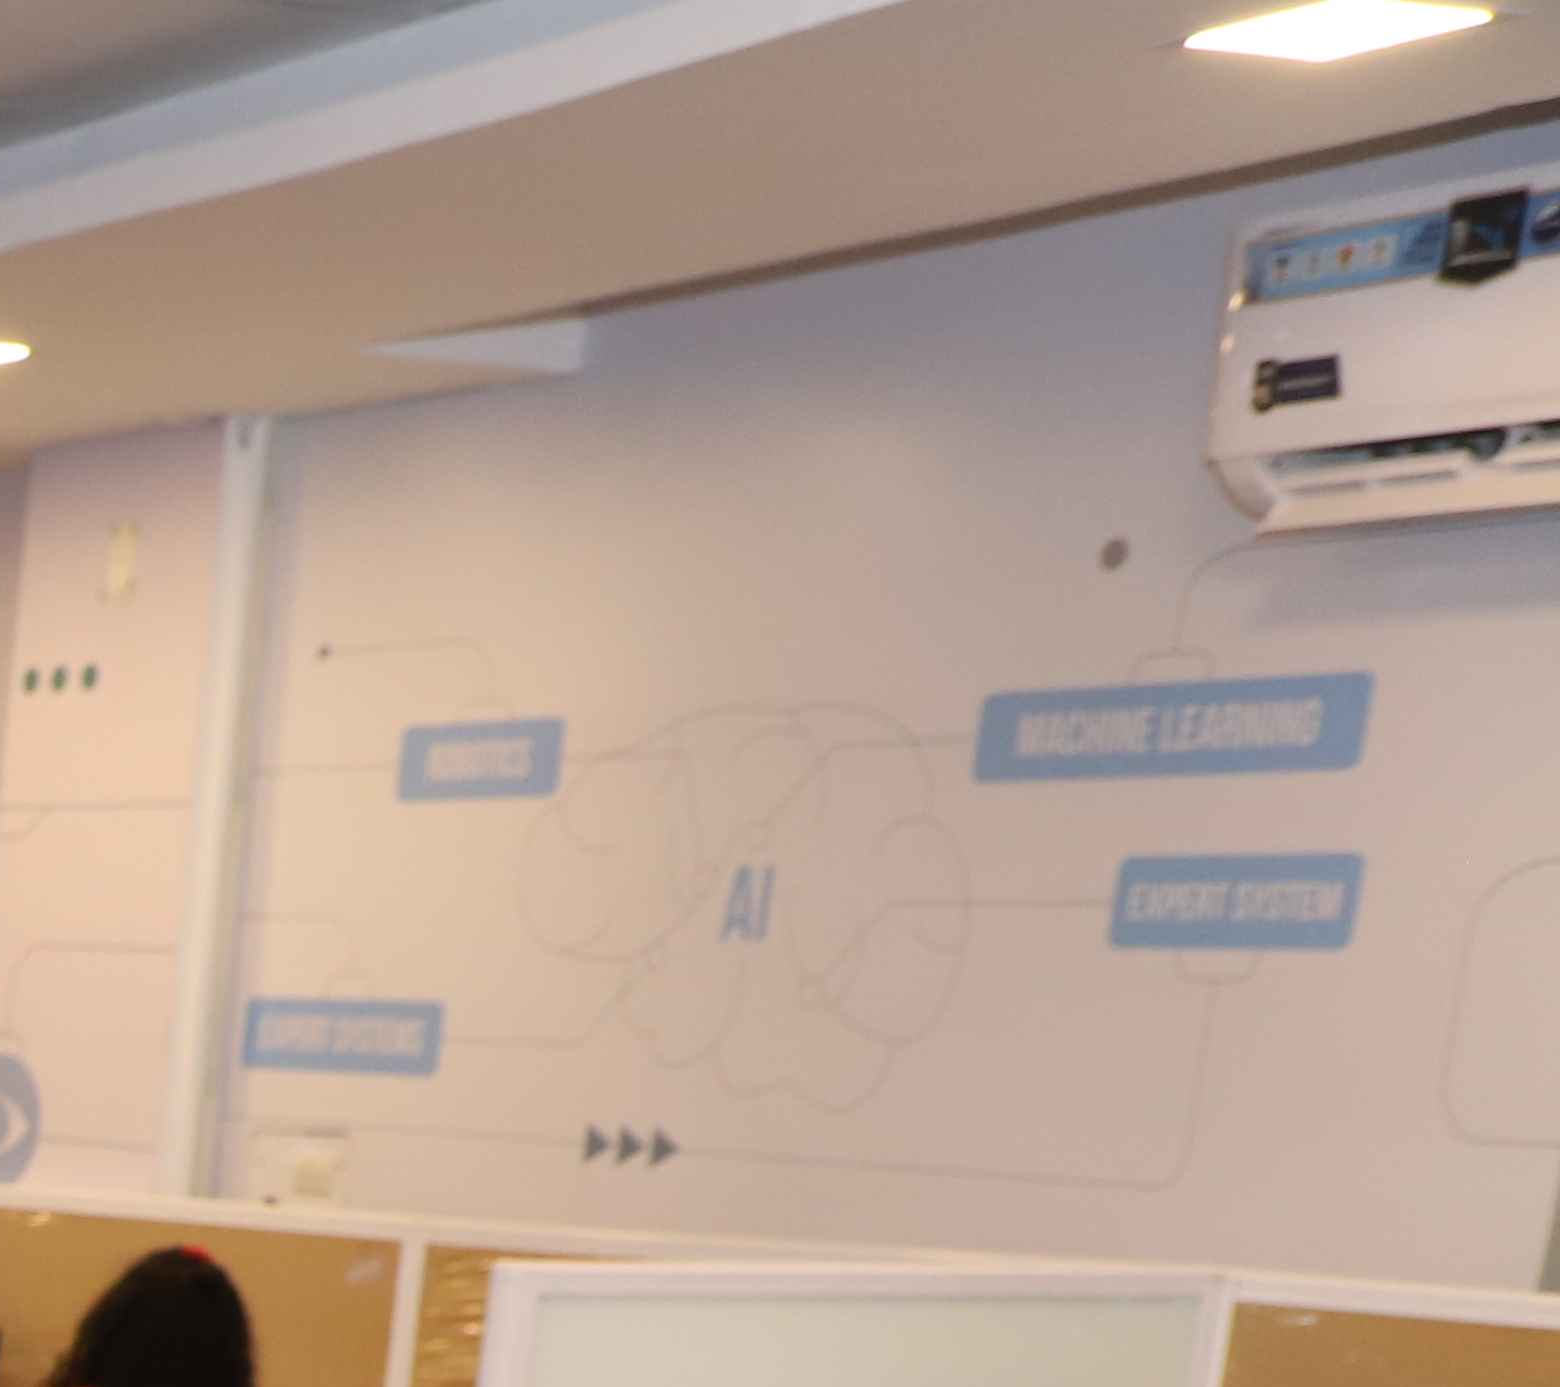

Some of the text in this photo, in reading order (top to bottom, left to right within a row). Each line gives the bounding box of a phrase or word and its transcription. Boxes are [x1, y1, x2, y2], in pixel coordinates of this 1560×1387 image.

[1016, 696, 1324, 755] MACHINE LEARNING
[719, 863, 777, 943] AI
